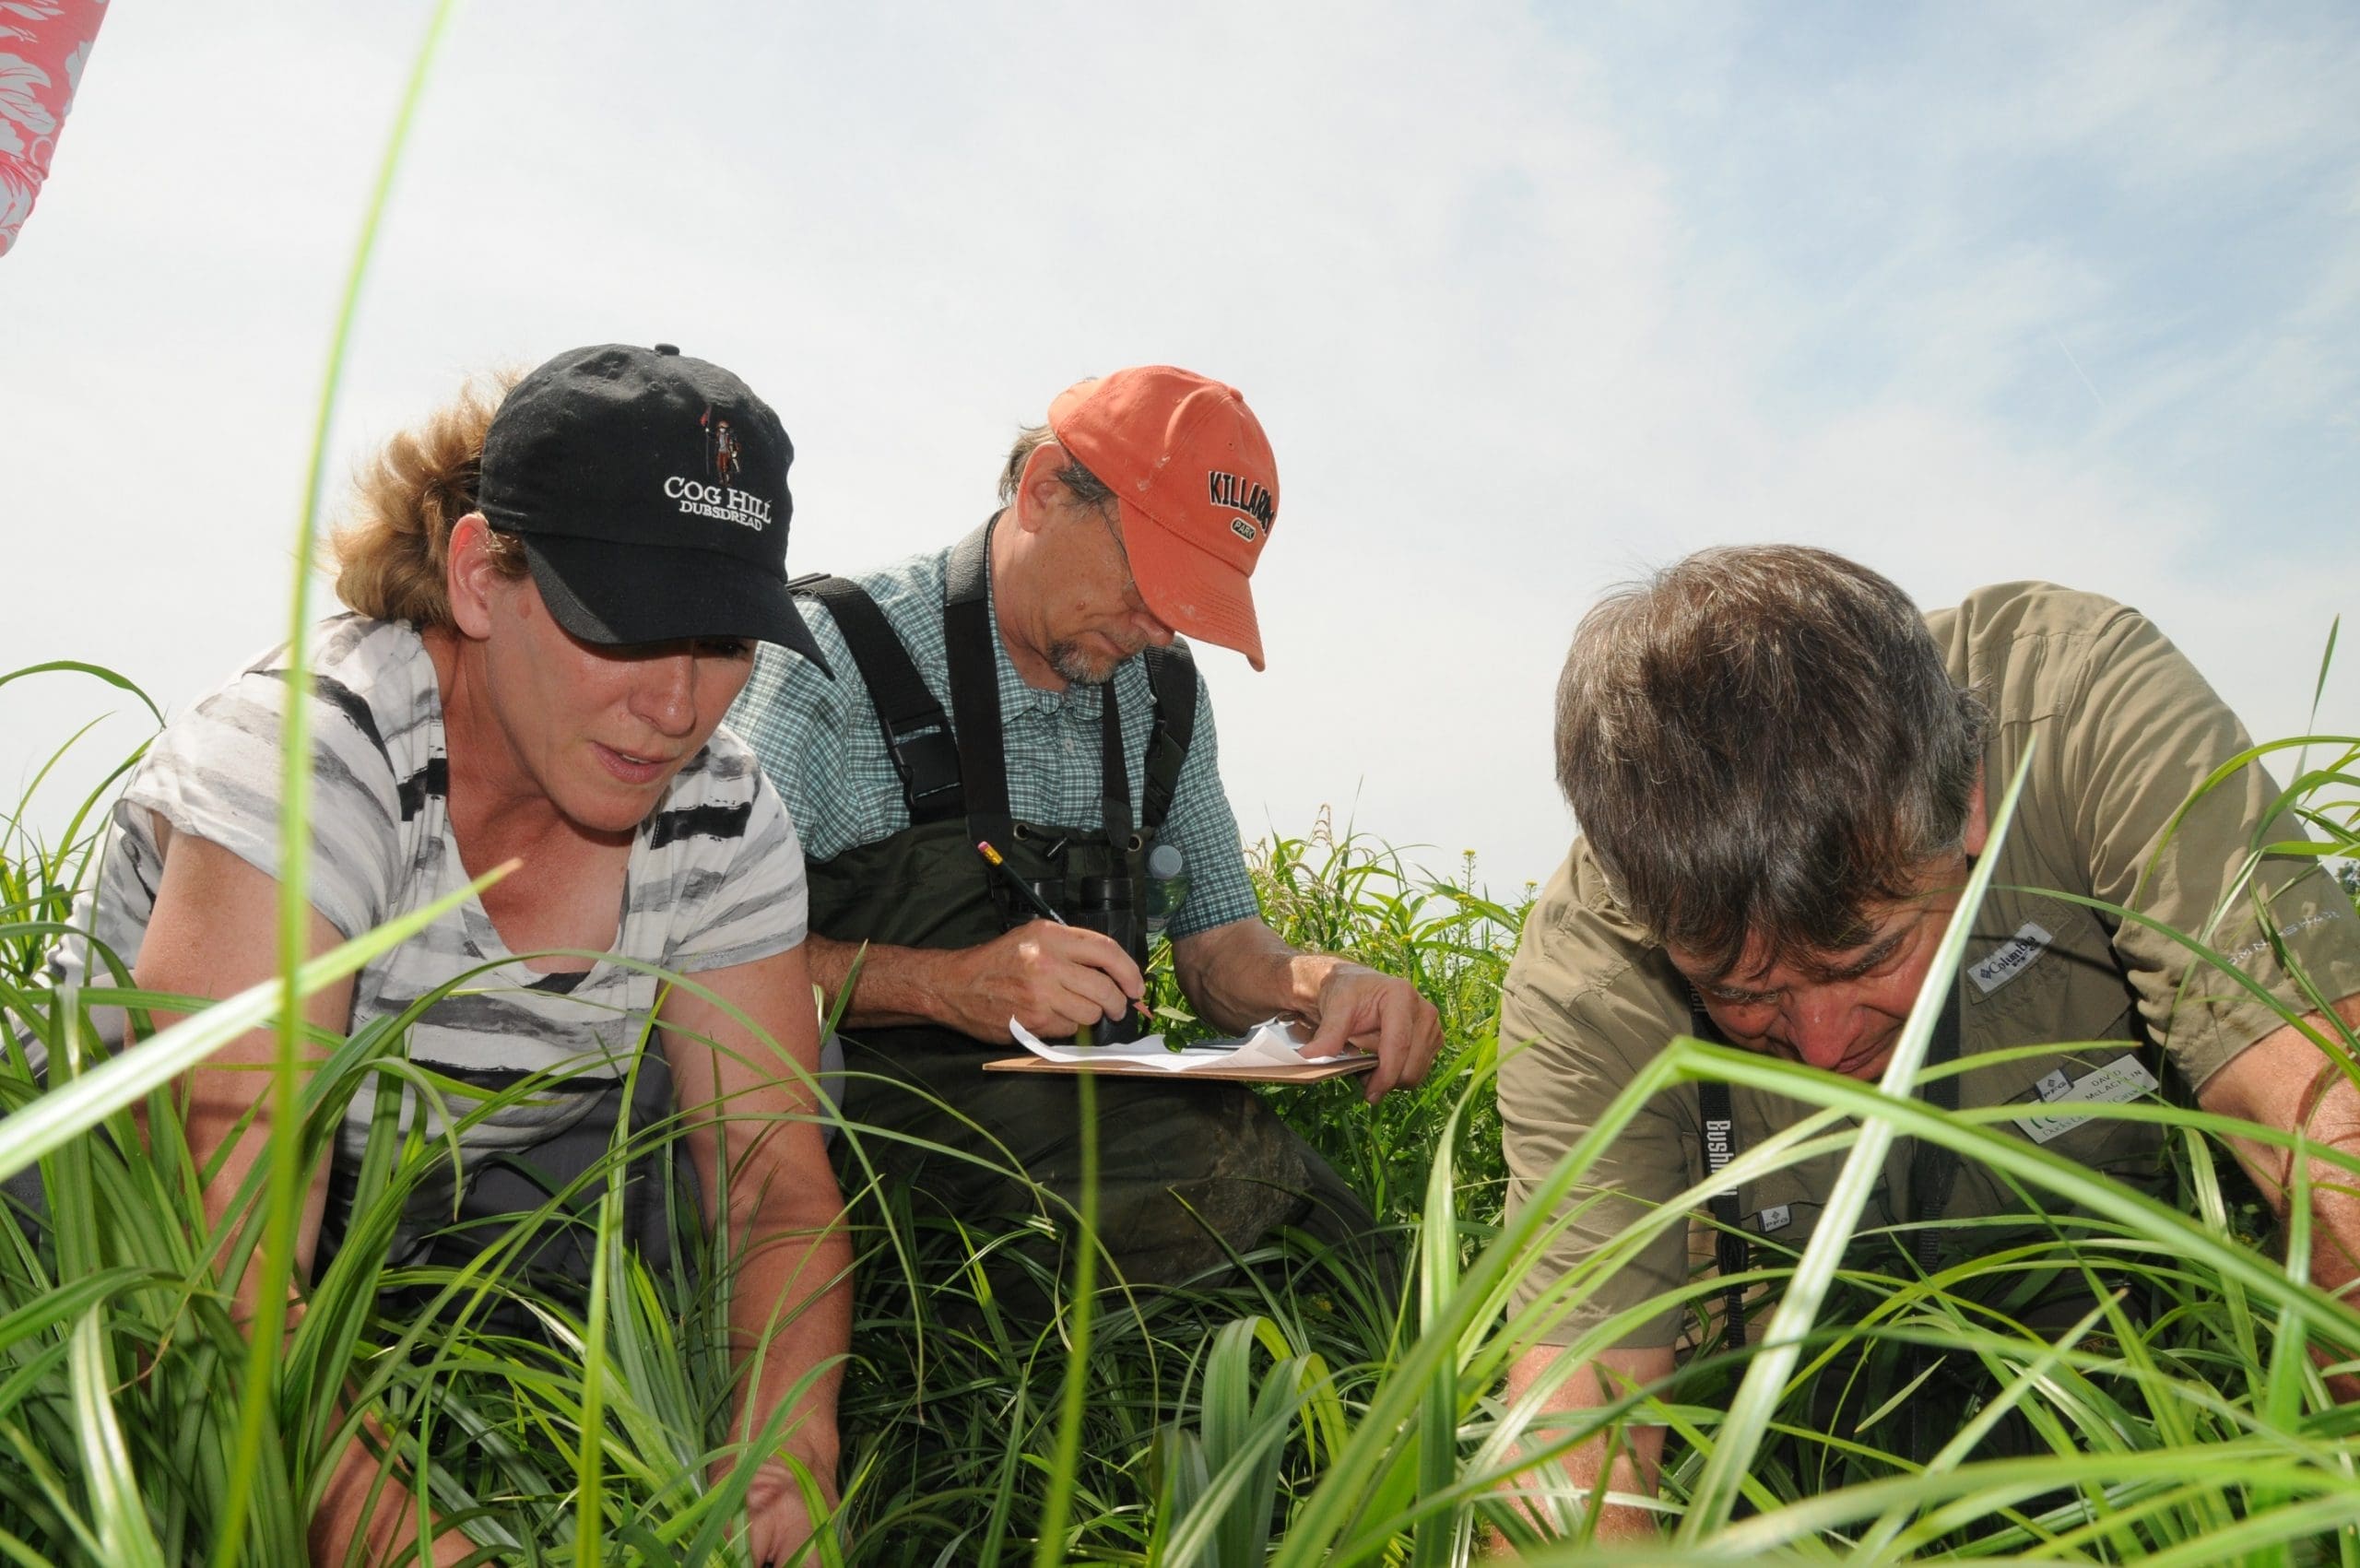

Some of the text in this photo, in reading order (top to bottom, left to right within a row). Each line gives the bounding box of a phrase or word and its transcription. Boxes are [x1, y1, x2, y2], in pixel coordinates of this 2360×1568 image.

[664, 476, 773, 525] COG HILL
[678, 500, 762, 532] DUBSDREAD
[1233, 520, 1255, 539] PARK
[1988, 935, 2041, 975] Columbia
[2090, 1069, 2122, 1088] DAVD
